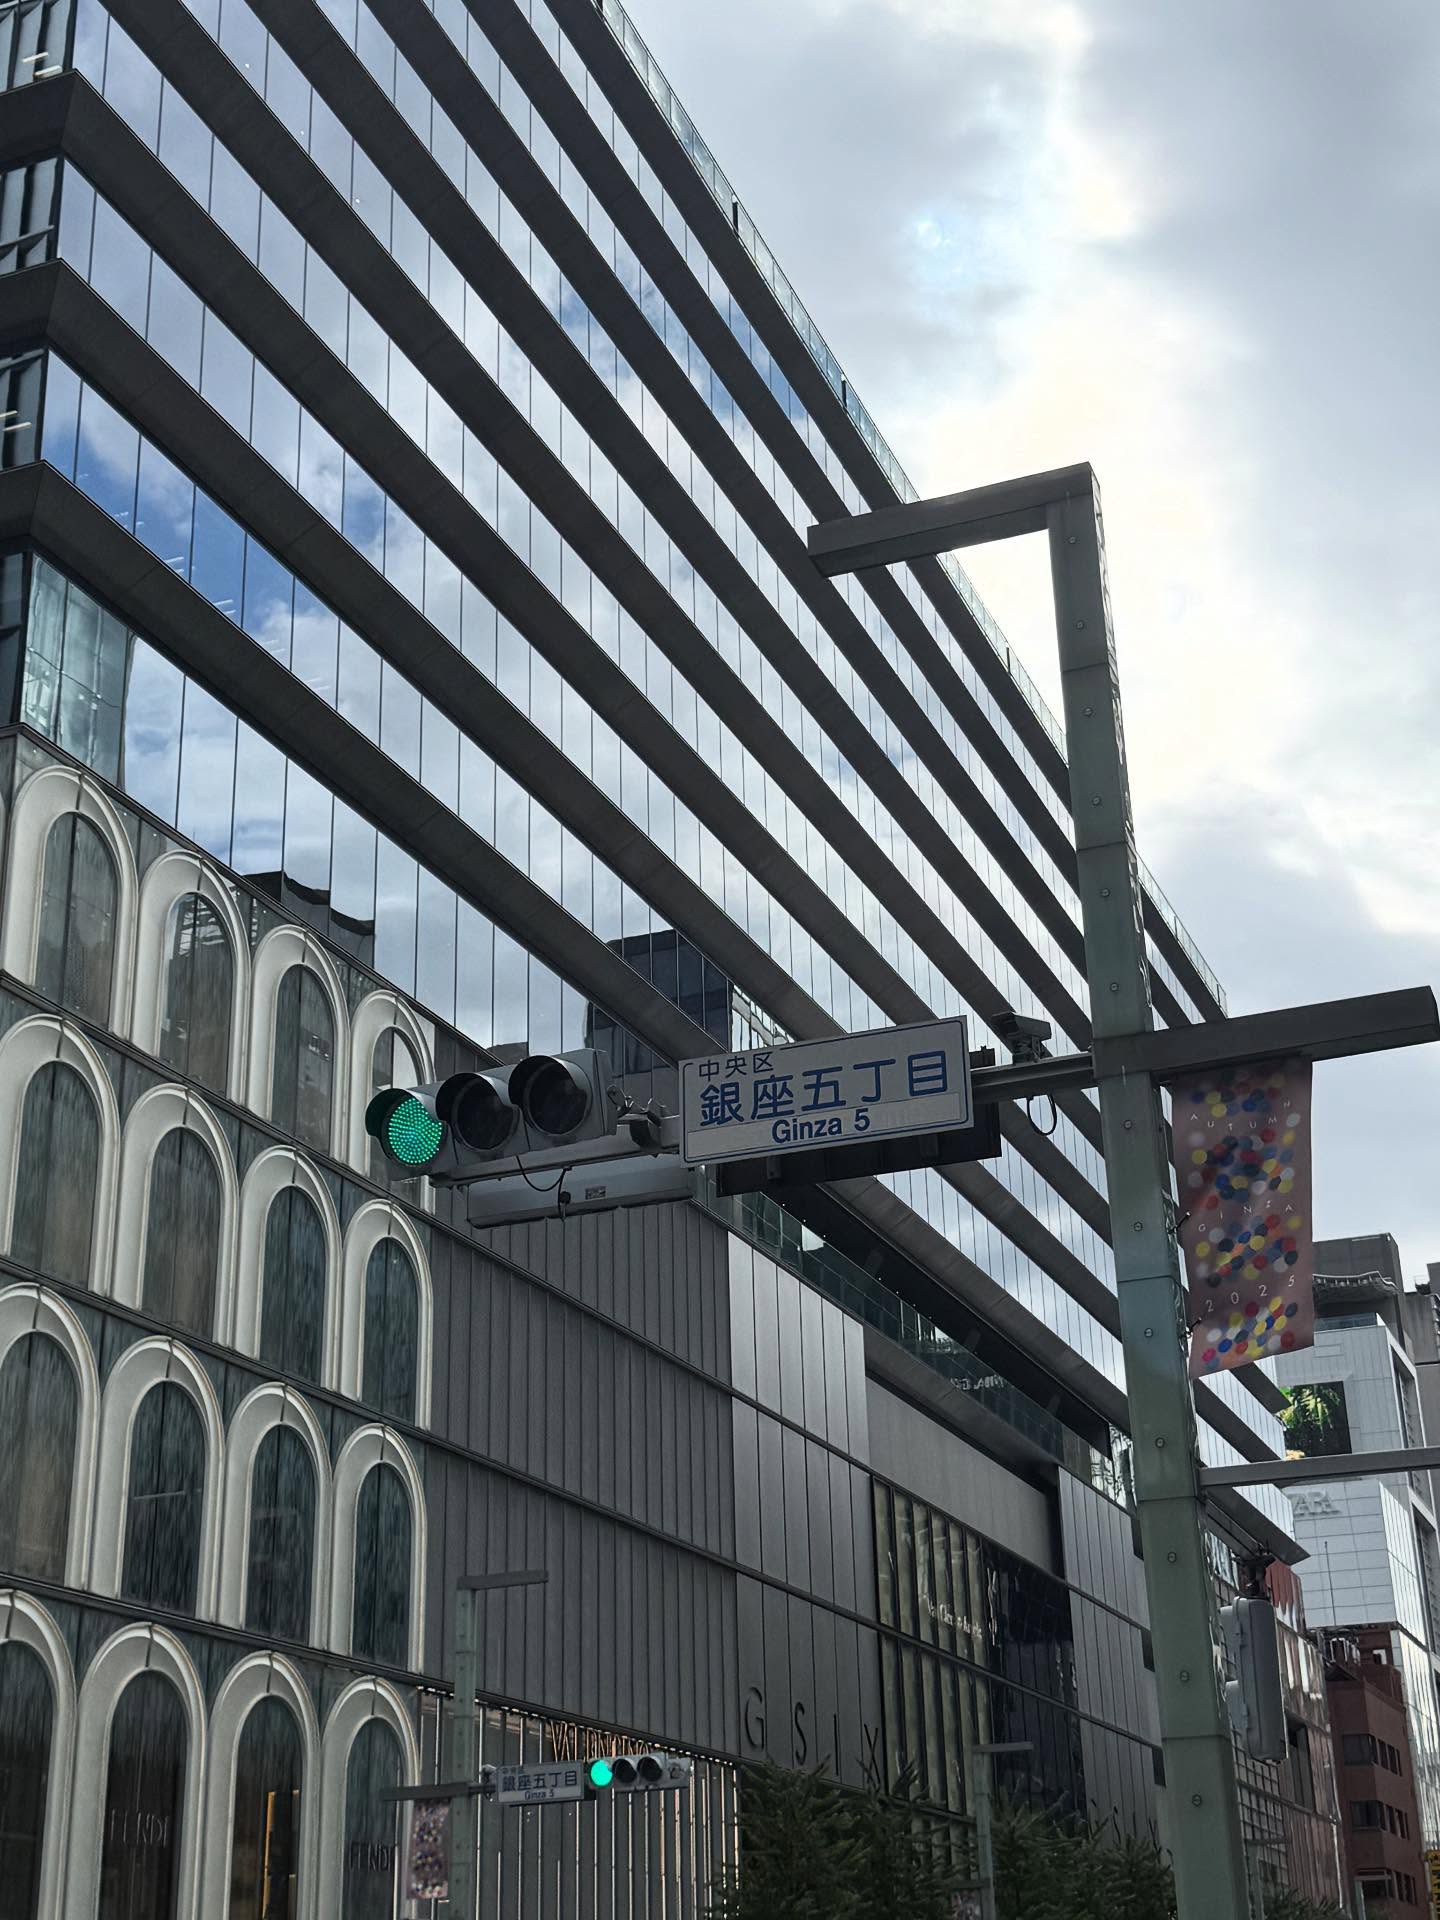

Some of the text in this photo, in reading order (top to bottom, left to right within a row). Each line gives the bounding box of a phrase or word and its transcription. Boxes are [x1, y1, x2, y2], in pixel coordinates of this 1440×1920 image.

[699, 1051, 774, 1082] 中央区
[699, 1050, 949, 1127] 銀座五丁目
[771, 1107, 871, 1144] Ginza 5
[1190, 1100, 1292, 1132] AUTUMN
[1198, 1199, 1294, 1233] GINZA
[1205, 1274, 1296, 1313] 2025
[502, 1770, 578, 1793] 銀座五丁目
